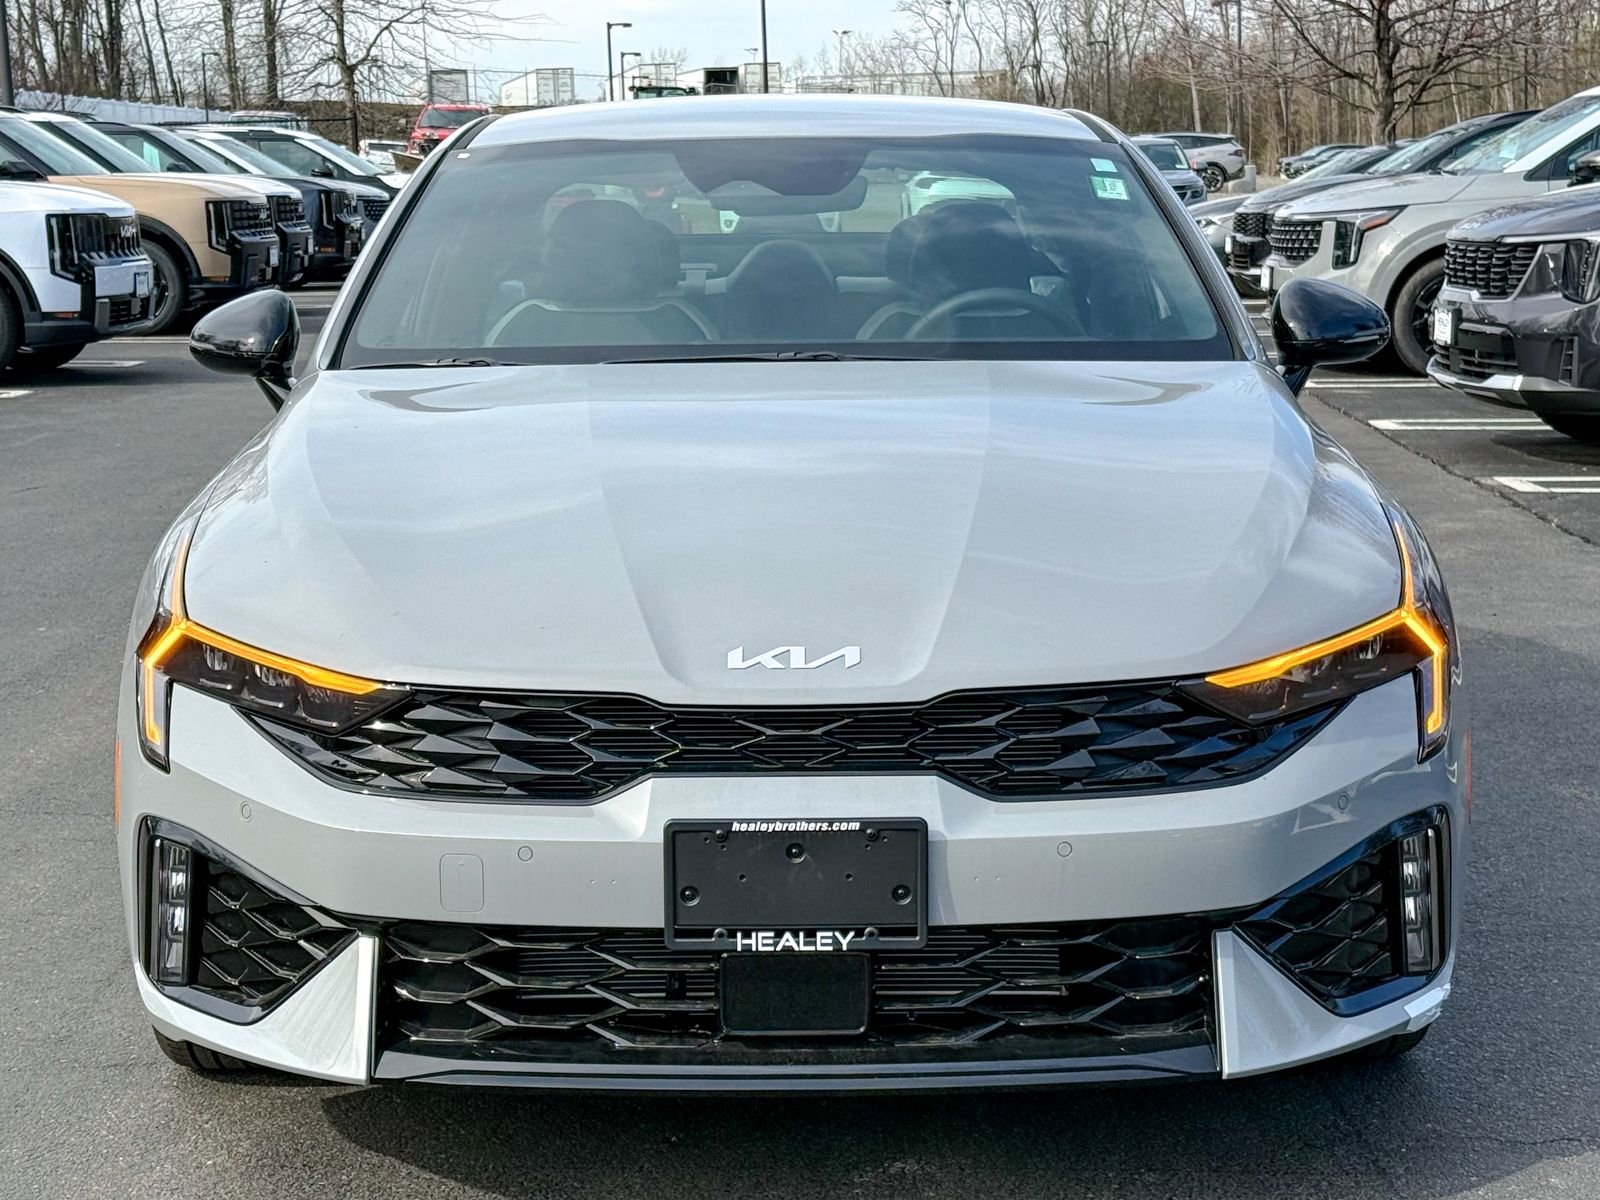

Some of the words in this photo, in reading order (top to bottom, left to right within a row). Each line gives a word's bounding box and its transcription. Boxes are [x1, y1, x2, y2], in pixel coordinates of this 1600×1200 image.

[727, 645, 861, 669] KIA
[731, 820, 861, 833] healeybrothers.com
[736, 931, 855, 951] HEALEY
